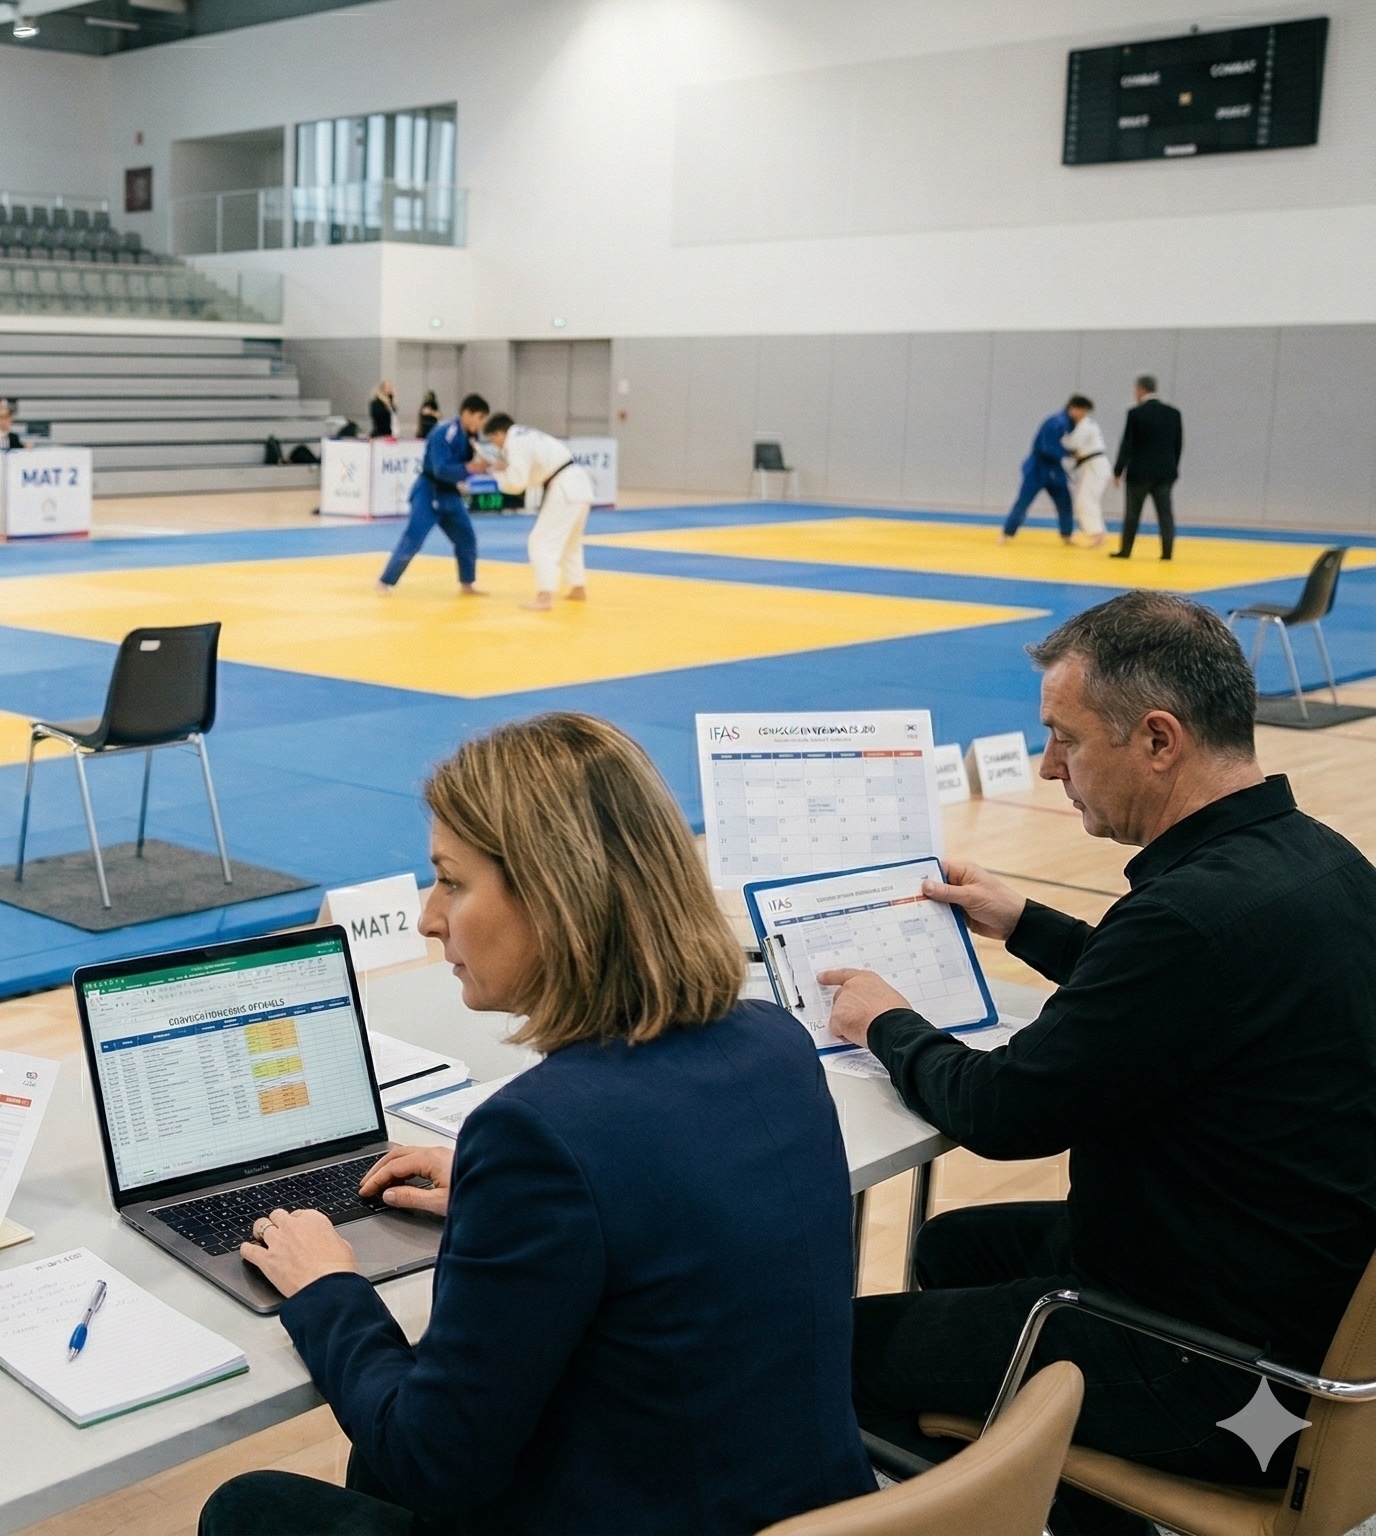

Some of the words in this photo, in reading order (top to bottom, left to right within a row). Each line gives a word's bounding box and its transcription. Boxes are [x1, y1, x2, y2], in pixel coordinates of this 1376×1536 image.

[21, 467, 62, 488] MAT
[68, 467, 78, 486] 2
[709, 726, 741, 744] IFAS
[351, 914, 390, 942] MAT
[397, 911, 409, 931] 2
